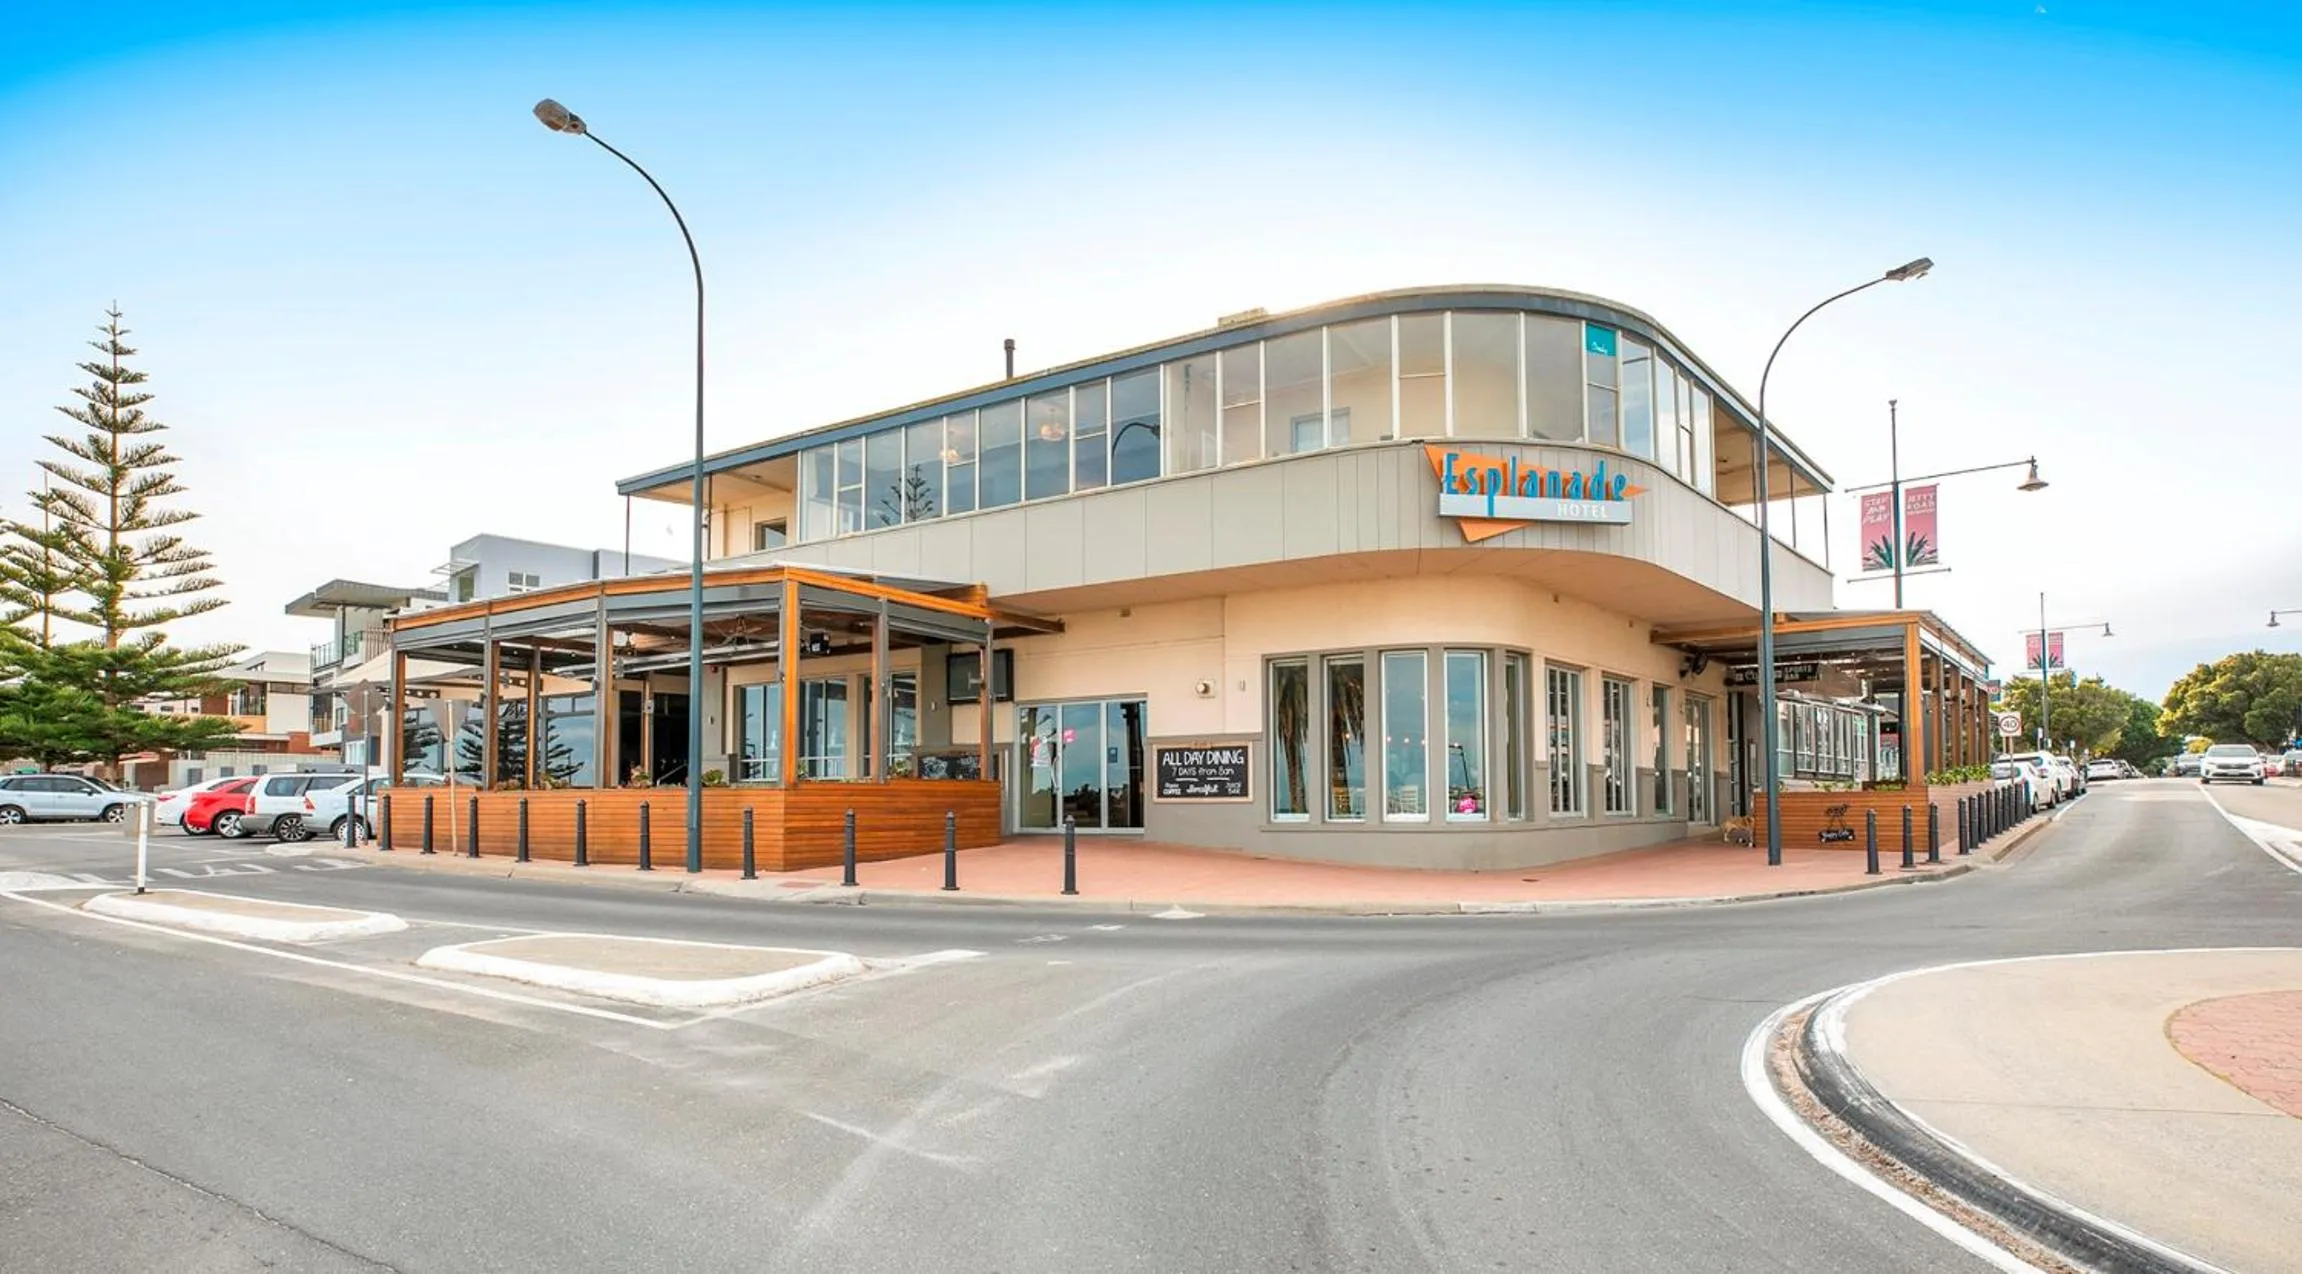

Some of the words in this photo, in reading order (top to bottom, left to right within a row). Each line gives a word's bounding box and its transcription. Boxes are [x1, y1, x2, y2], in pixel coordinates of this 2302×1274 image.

[1443, 453, 1627, 517] Esplanade
[1557, 503, 1608, 518] HOTEL
[2004, 720, 2017, 729] 40
[1162, 752, 1182, 766] ALL
[1183, 751, 1205, 765] DAY
[1207, 749, 1244, 765] DINING
[1172, 767, 1177, 777] 7
[1178, 767, 1197, 776] DAYS
